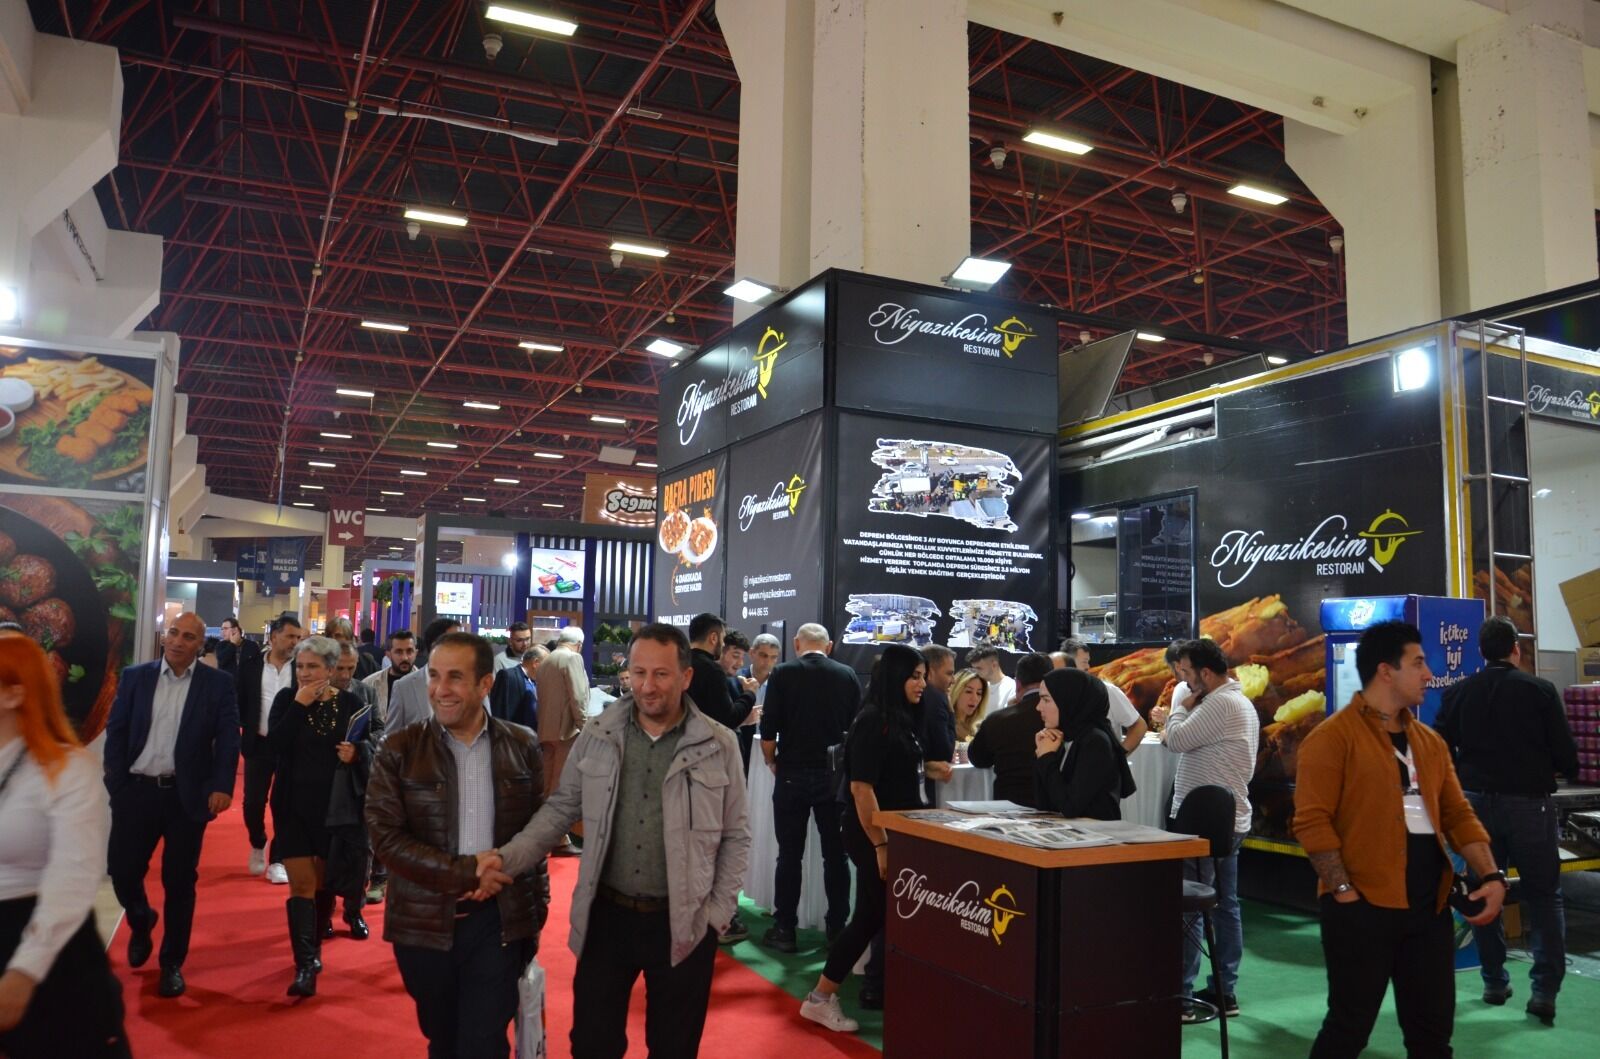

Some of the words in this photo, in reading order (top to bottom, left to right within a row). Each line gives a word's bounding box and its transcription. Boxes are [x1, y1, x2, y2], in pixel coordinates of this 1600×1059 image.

[868, 302, 1002, 345] Niyazikesim
[963, 343, 1000, 358] RESTORAN
[677, 346, 758, 446] Niyazikesim
[730, 393, 758, 417] RESTORAN
[1527, 384, 1591, 413] Niyazikesim
[663, 478, 688, 513] BAFRA
[738, 481, 790, 532] Niyazikesim
[333, 508, 364, 526] WC
[843, 538, 904, 549] VATANDAŞLARIMIZA
[914, 544, 937, 552] KOLLUK
[937, 546, 985, 556] KUVVETLERİMİZE
[985, 548, 1012, 557] HİZMETTE
[859, 531, 885, 539] DEPREM
[886, 533, 922, 542] BÖLGESİNDE
[937, 538, 964, 546] BOYUNCA
[965, 540, 1000, 548] DEPREMDEN
[1000, 542, 1030, 551] ETKİLENEN
[1211, 514, 1367, 588] Niyazikesim
[860, 555, 883, 564] HİZMET
[883, 558, 911, 566] VEREREK
[912, 560, 945, 569] TOPLAMDA
[946, 562, 970, 570] DEPREM
[970, 563, 1001, 573] SÜRESİNCE
[1009, 566, 1031, 575] MİLYON
[878, 549, 904, 557] GÜNLÜK
[917, 552, 945, 560] BÖLGEDE
[945, 554, 977, 563] ORTALAMA
[995, 557, 1013, 565] KİŞİYE
[1316, 561, 1365, 577] RESTORAN
[886, 565, 907, 575] KİŞİLİK
[907, 568, 928, 576] YEMEK
[1439, 621, 1468, 645] İçtikçe
[1446, 646, 1462, 670] iyi
[892, 867, 993, 919] Niyazikesim
[960, 918, 989, 938] RESTORAN
